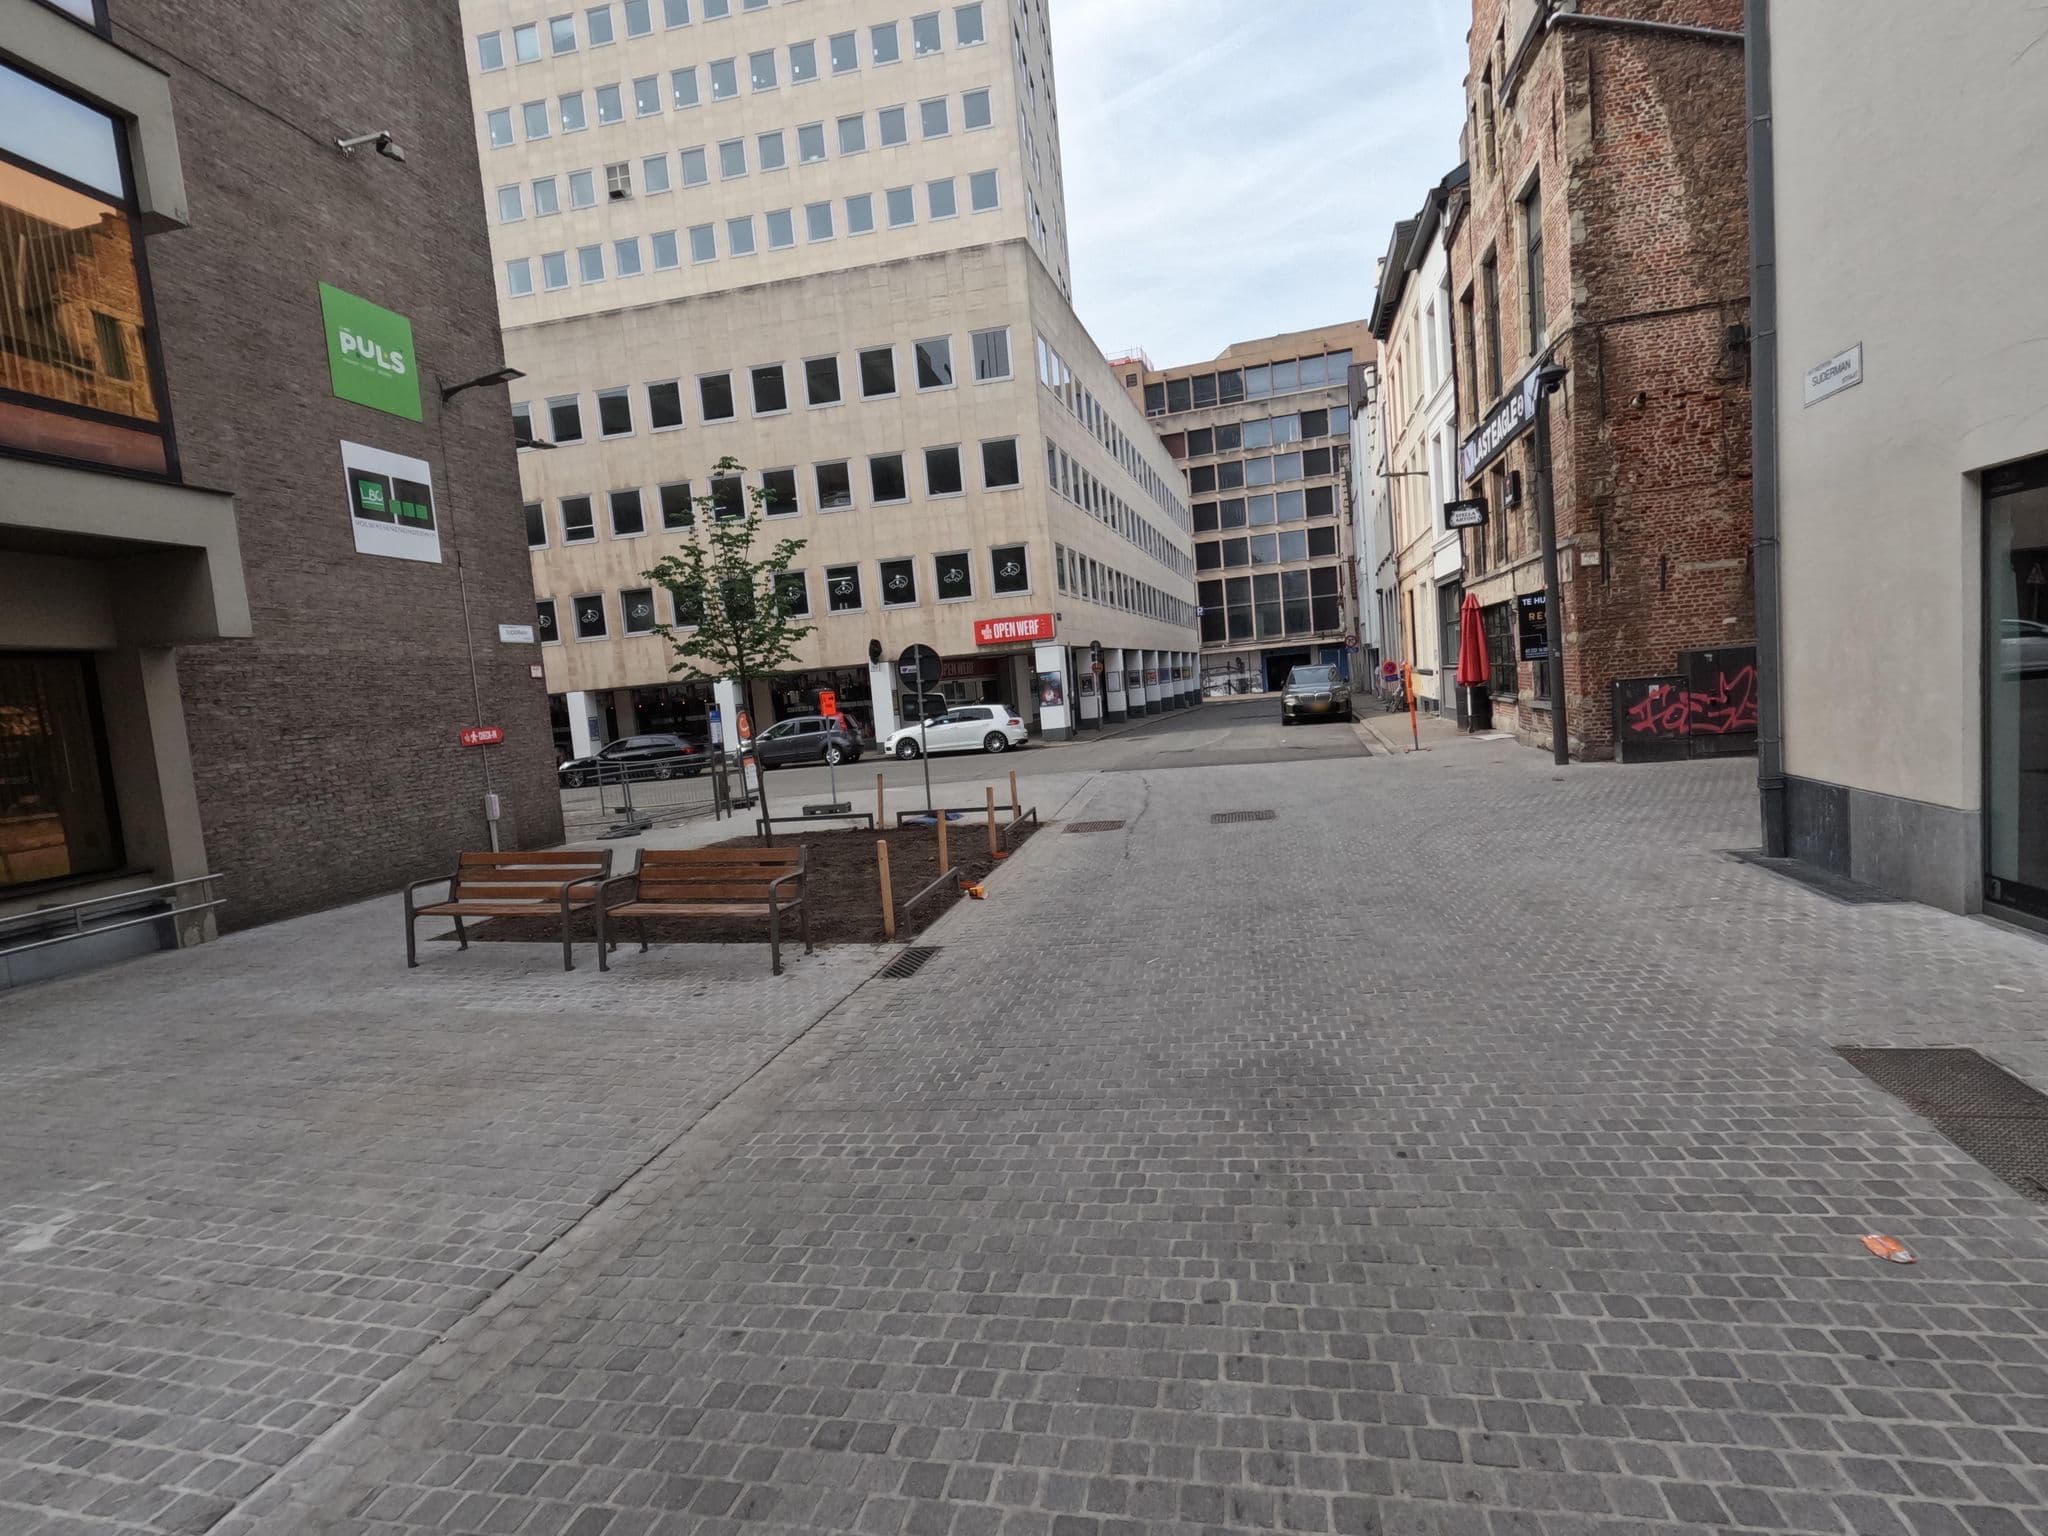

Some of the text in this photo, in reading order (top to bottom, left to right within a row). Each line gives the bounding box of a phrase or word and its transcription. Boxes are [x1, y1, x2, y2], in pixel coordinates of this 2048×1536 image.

[339, 331, 405, 375] PULS
[1522, 596, 1546, 607] TE HU
[993, 619, 1040, 639] OPEN WERF
